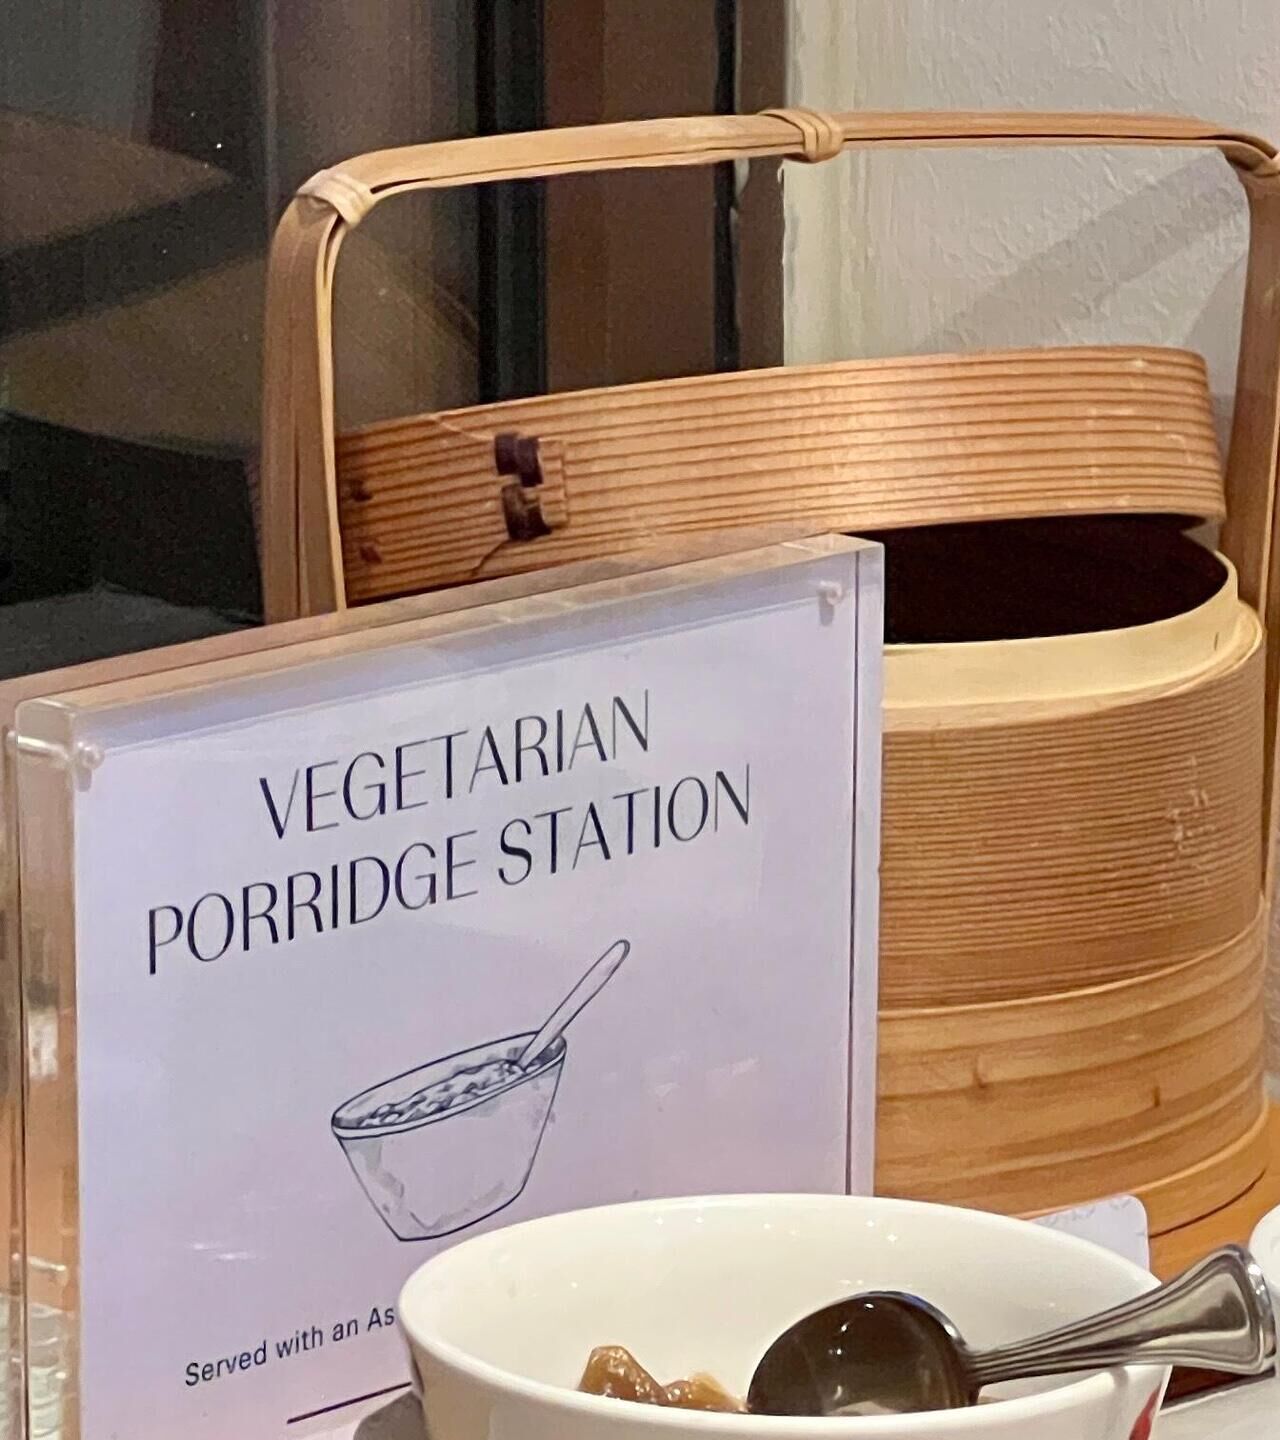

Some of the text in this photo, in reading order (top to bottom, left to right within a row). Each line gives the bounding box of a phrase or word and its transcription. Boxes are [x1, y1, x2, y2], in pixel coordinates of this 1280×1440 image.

[258, 689, 650, 840] VEGETARIAN
[147, 763, 753, 976] PORRIDGE STATION
[184, 1307, 396, 1388] Served with an As
